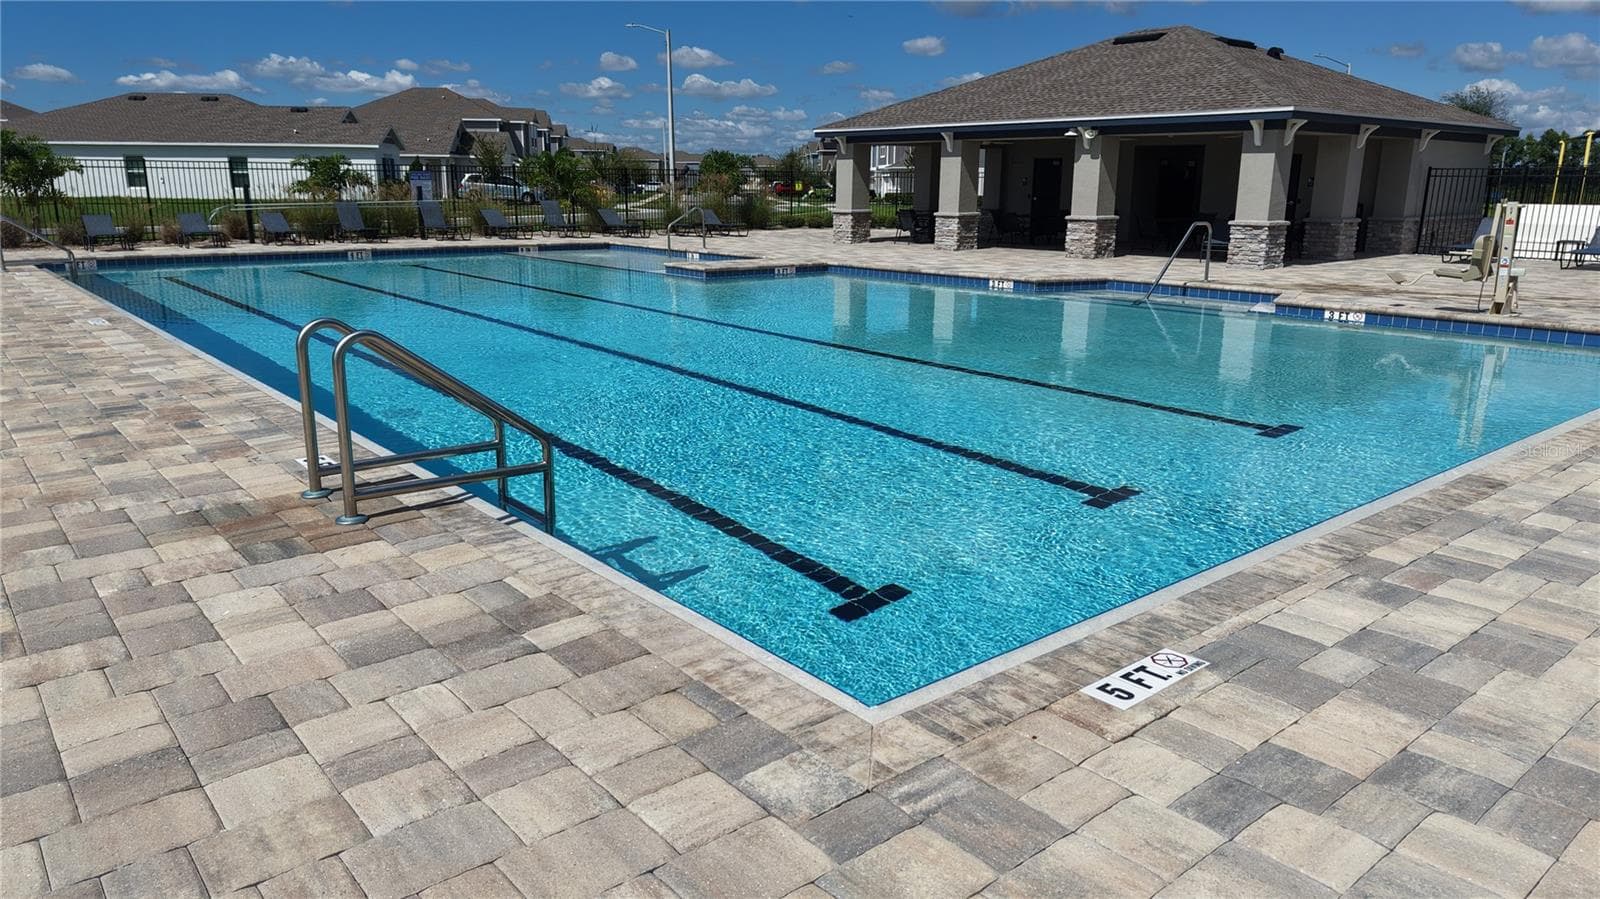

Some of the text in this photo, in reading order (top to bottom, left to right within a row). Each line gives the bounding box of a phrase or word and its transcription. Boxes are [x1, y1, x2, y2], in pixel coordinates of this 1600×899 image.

[1328, 310, 1350, 322] 3 FT
[1096, 665, 1172, 700] 5 FT.
